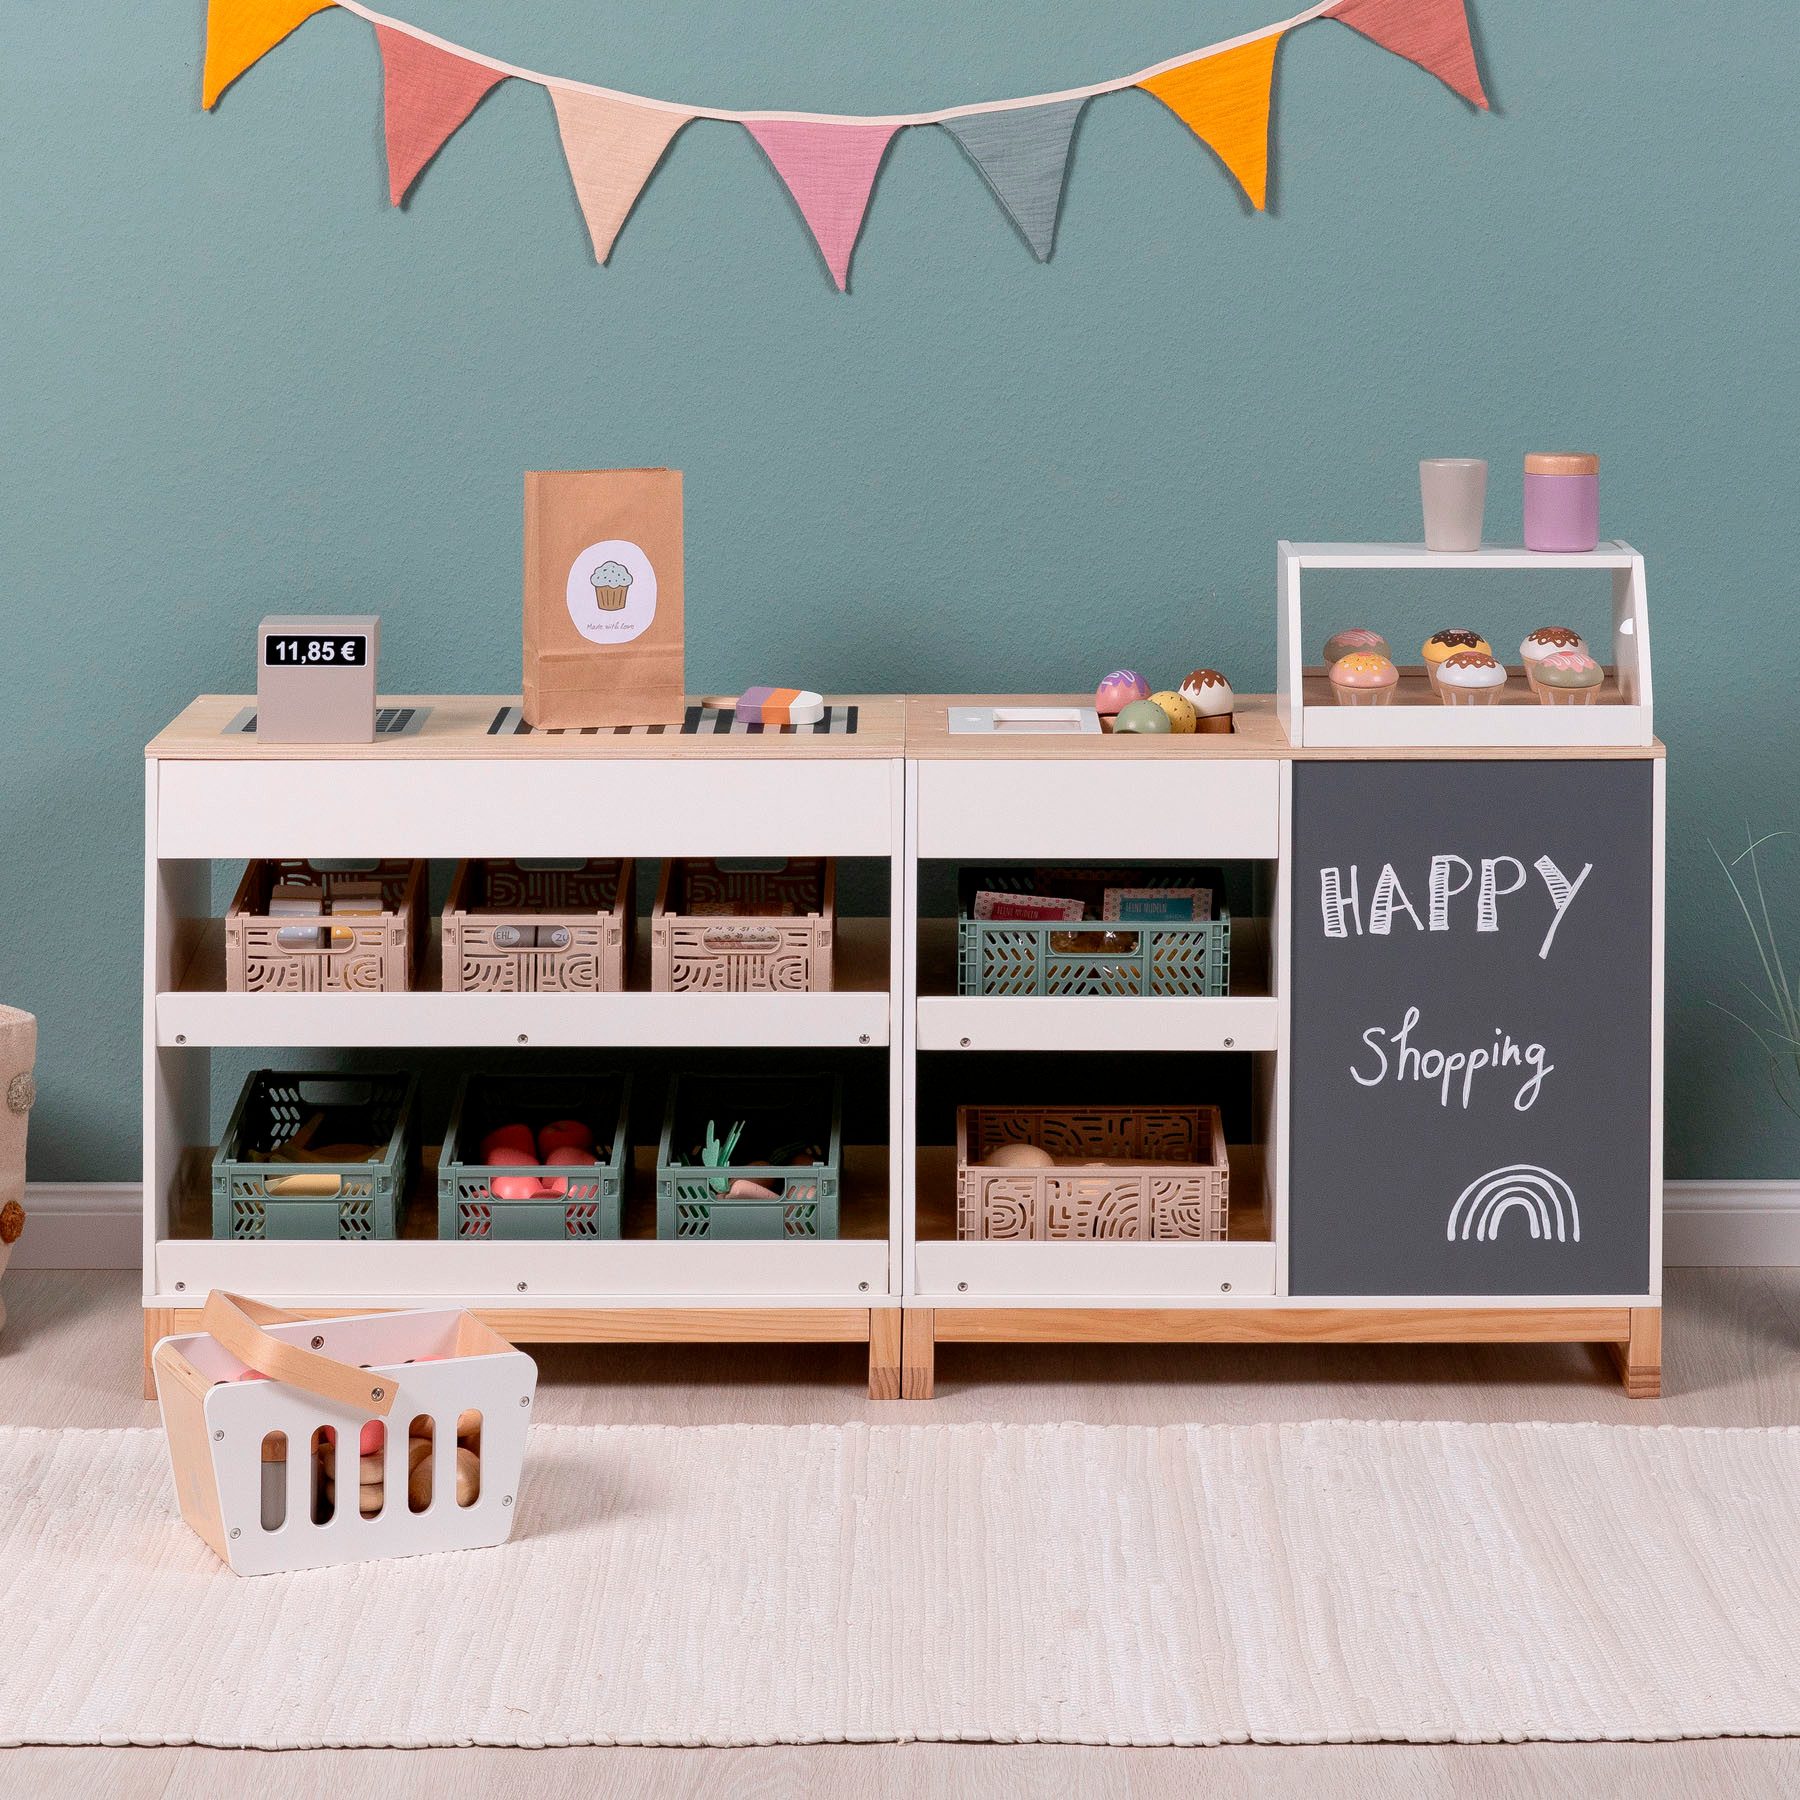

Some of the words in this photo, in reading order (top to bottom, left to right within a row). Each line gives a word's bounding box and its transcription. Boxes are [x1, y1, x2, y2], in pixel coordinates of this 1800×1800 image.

[275, 641, 335, 664] 11,85
[340, 641, 356, 662] €
[1319, 854, 1593, 960] HAPPY
